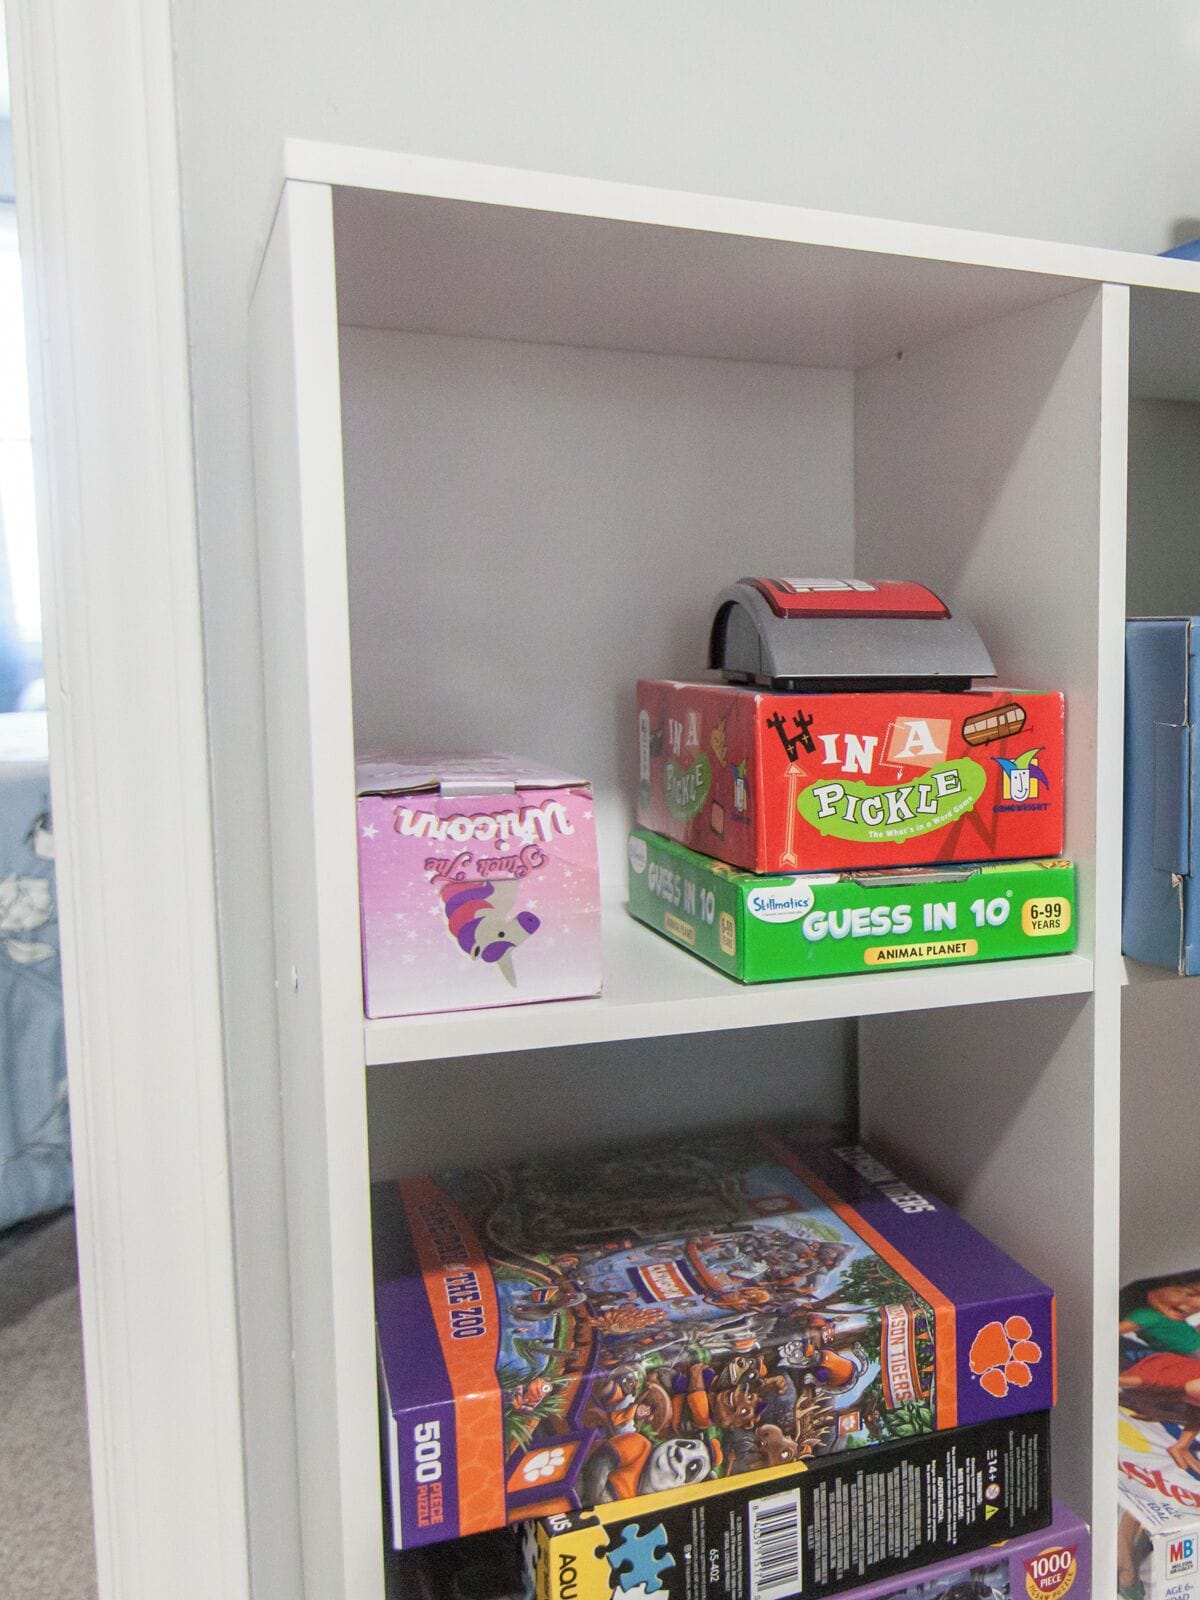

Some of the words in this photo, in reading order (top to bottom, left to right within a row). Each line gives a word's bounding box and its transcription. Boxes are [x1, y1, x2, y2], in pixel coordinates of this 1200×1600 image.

[818, 733, 878, 775] IN
[894, 720, 945, 759] A
[812, 768, 963, 826] PICKLE
[393, 799, 576, 852] Unicorn
[868, 830, 884, 840] The
[886, 826, 915, 838] What's
[916, 823, 926, 832] in
[932, 811, 953, 827] Word
[952, 796, 974, 816] Game
[425, 851, 473, 885] The
[476, 844, 550, 880] Stack
[753, 895, 809, 912] Skillmatics
[803, 905, 912, 942] GUESS
[923, 902, 957, 932] IN
[970, 897, 1011, 928] 10
[1030, 903, 1062, 919] 6-99
[1031, 919, 1061, 930] YEARS
[877, 946, 924, 961] ANIMAL
[926, 943, 967, 957] PLANET
[443, 1270, 483, 1305] THE
[449, 1305, 487, 1340] ZOO
[890, 1350, 914, 1402] TIGERS
[414, 1420, 442, 1483] 500
[988, 1459, 998, 1482] 14+
[416, 1484, 430, 1528] PUZZLE
[430, 1482, 444, 1525] PIECE
[709, 1548, 720, 1583] 65-402
[1030, 1551, 1072, 1579] 1000
[1169, 1539, 1194, 1563] MB
[1040, 1573, 1063, 1589] PIECE
[1165, 1584, 1182, 1598] AGE
